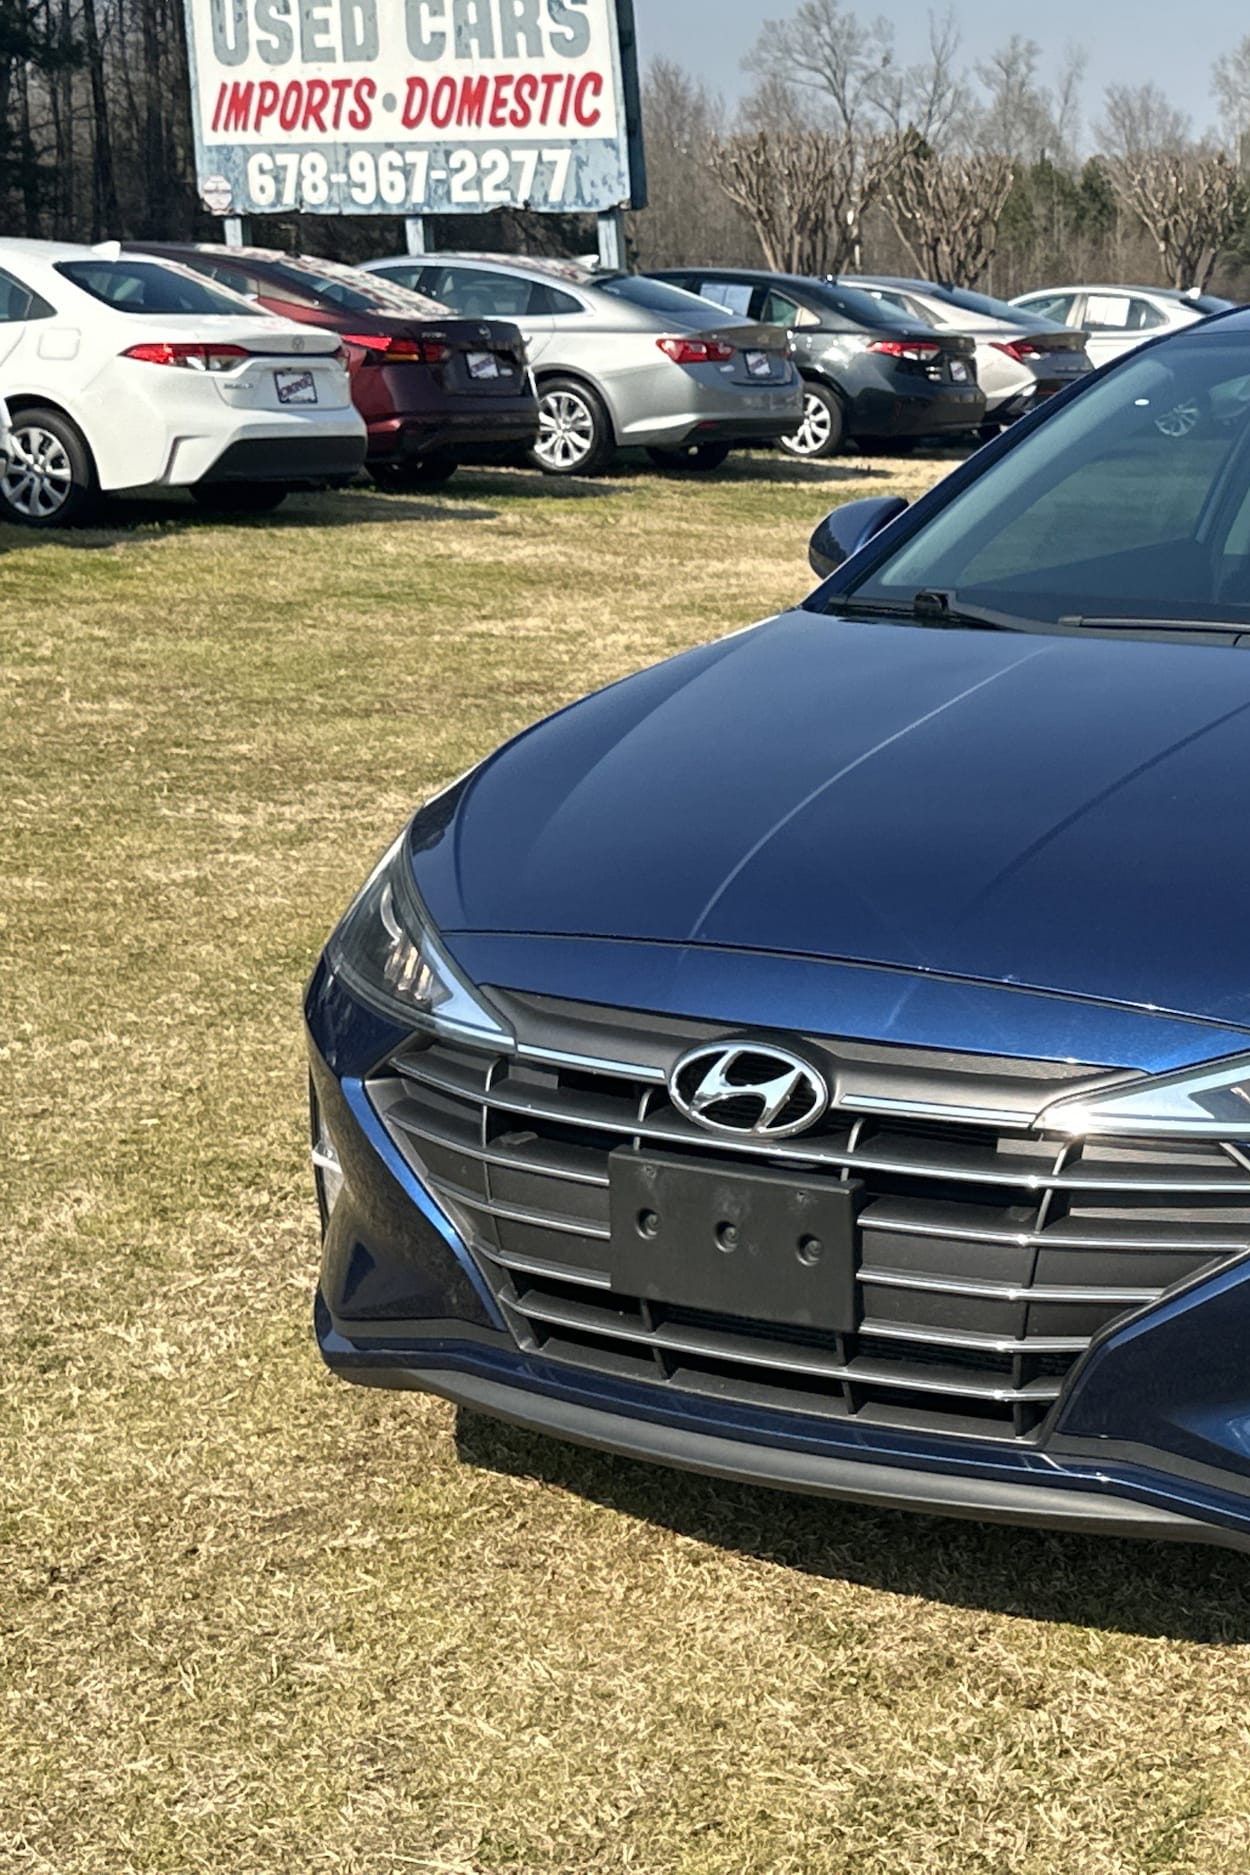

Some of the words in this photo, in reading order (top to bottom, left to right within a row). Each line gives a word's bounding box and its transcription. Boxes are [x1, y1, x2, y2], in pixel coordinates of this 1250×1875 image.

[210, 0, 380, 66] USED
[405, 0, 591, 62] CARS
[211, 77, 376, 132] IMPORTS
[401, 72, 603, 128] DOMESTIC
[246, 148, 572, 204] 678-967-2277
